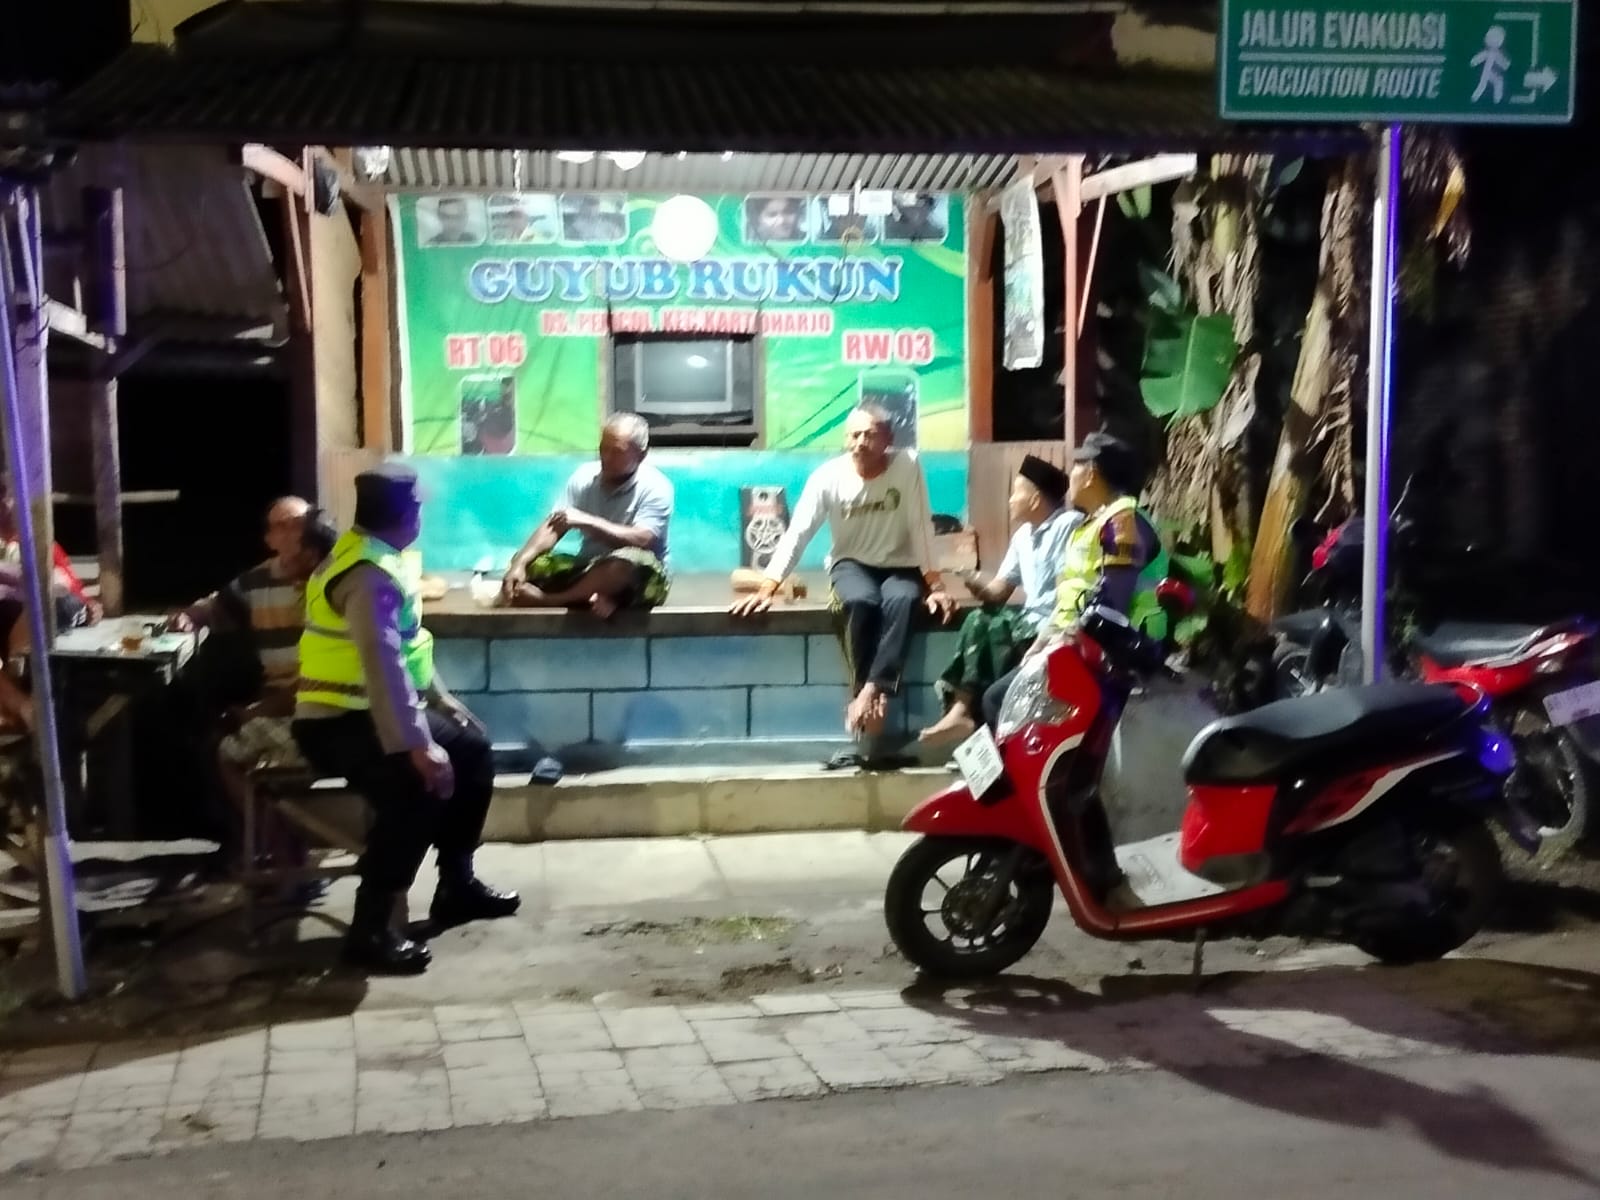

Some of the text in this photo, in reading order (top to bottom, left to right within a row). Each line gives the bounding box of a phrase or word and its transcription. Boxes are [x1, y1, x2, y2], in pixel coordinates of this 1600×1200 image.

[1238, 9, 1447, 50] JALUR EVAKUASI
[1238, 66, 1444, 99] EVACUATION ROUTE
[470, 256, 904, 303] GUYUB RUKUN
[448, 332, 524, 366] RT 06
[845, 330, 932, 362] RW 03
